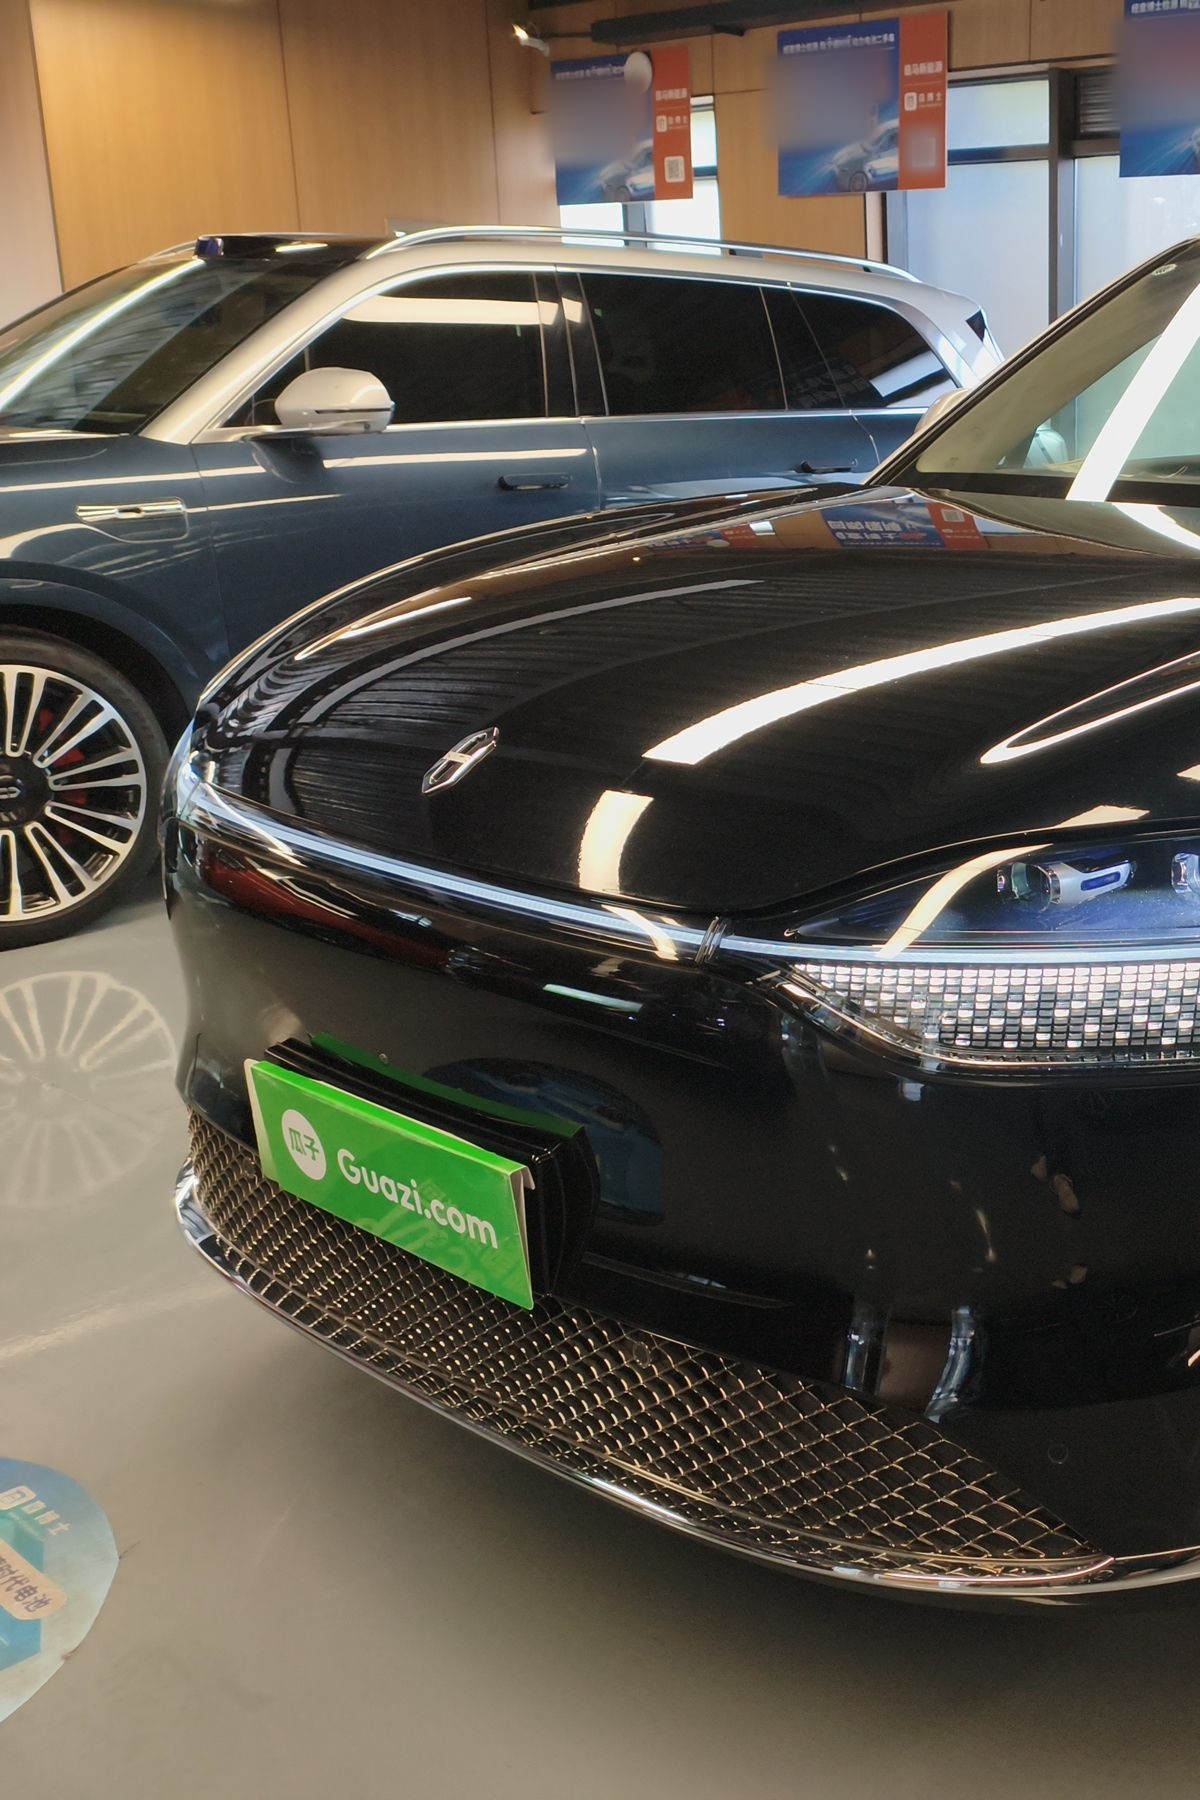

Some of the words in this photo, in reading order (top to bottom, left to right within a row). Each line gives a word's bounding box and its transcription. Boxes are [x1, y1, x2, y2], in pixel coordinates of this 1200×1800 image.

[337, 1148, 498, 1249] Guazi.com
[0, 1558, 53, 1612] 时代电池
